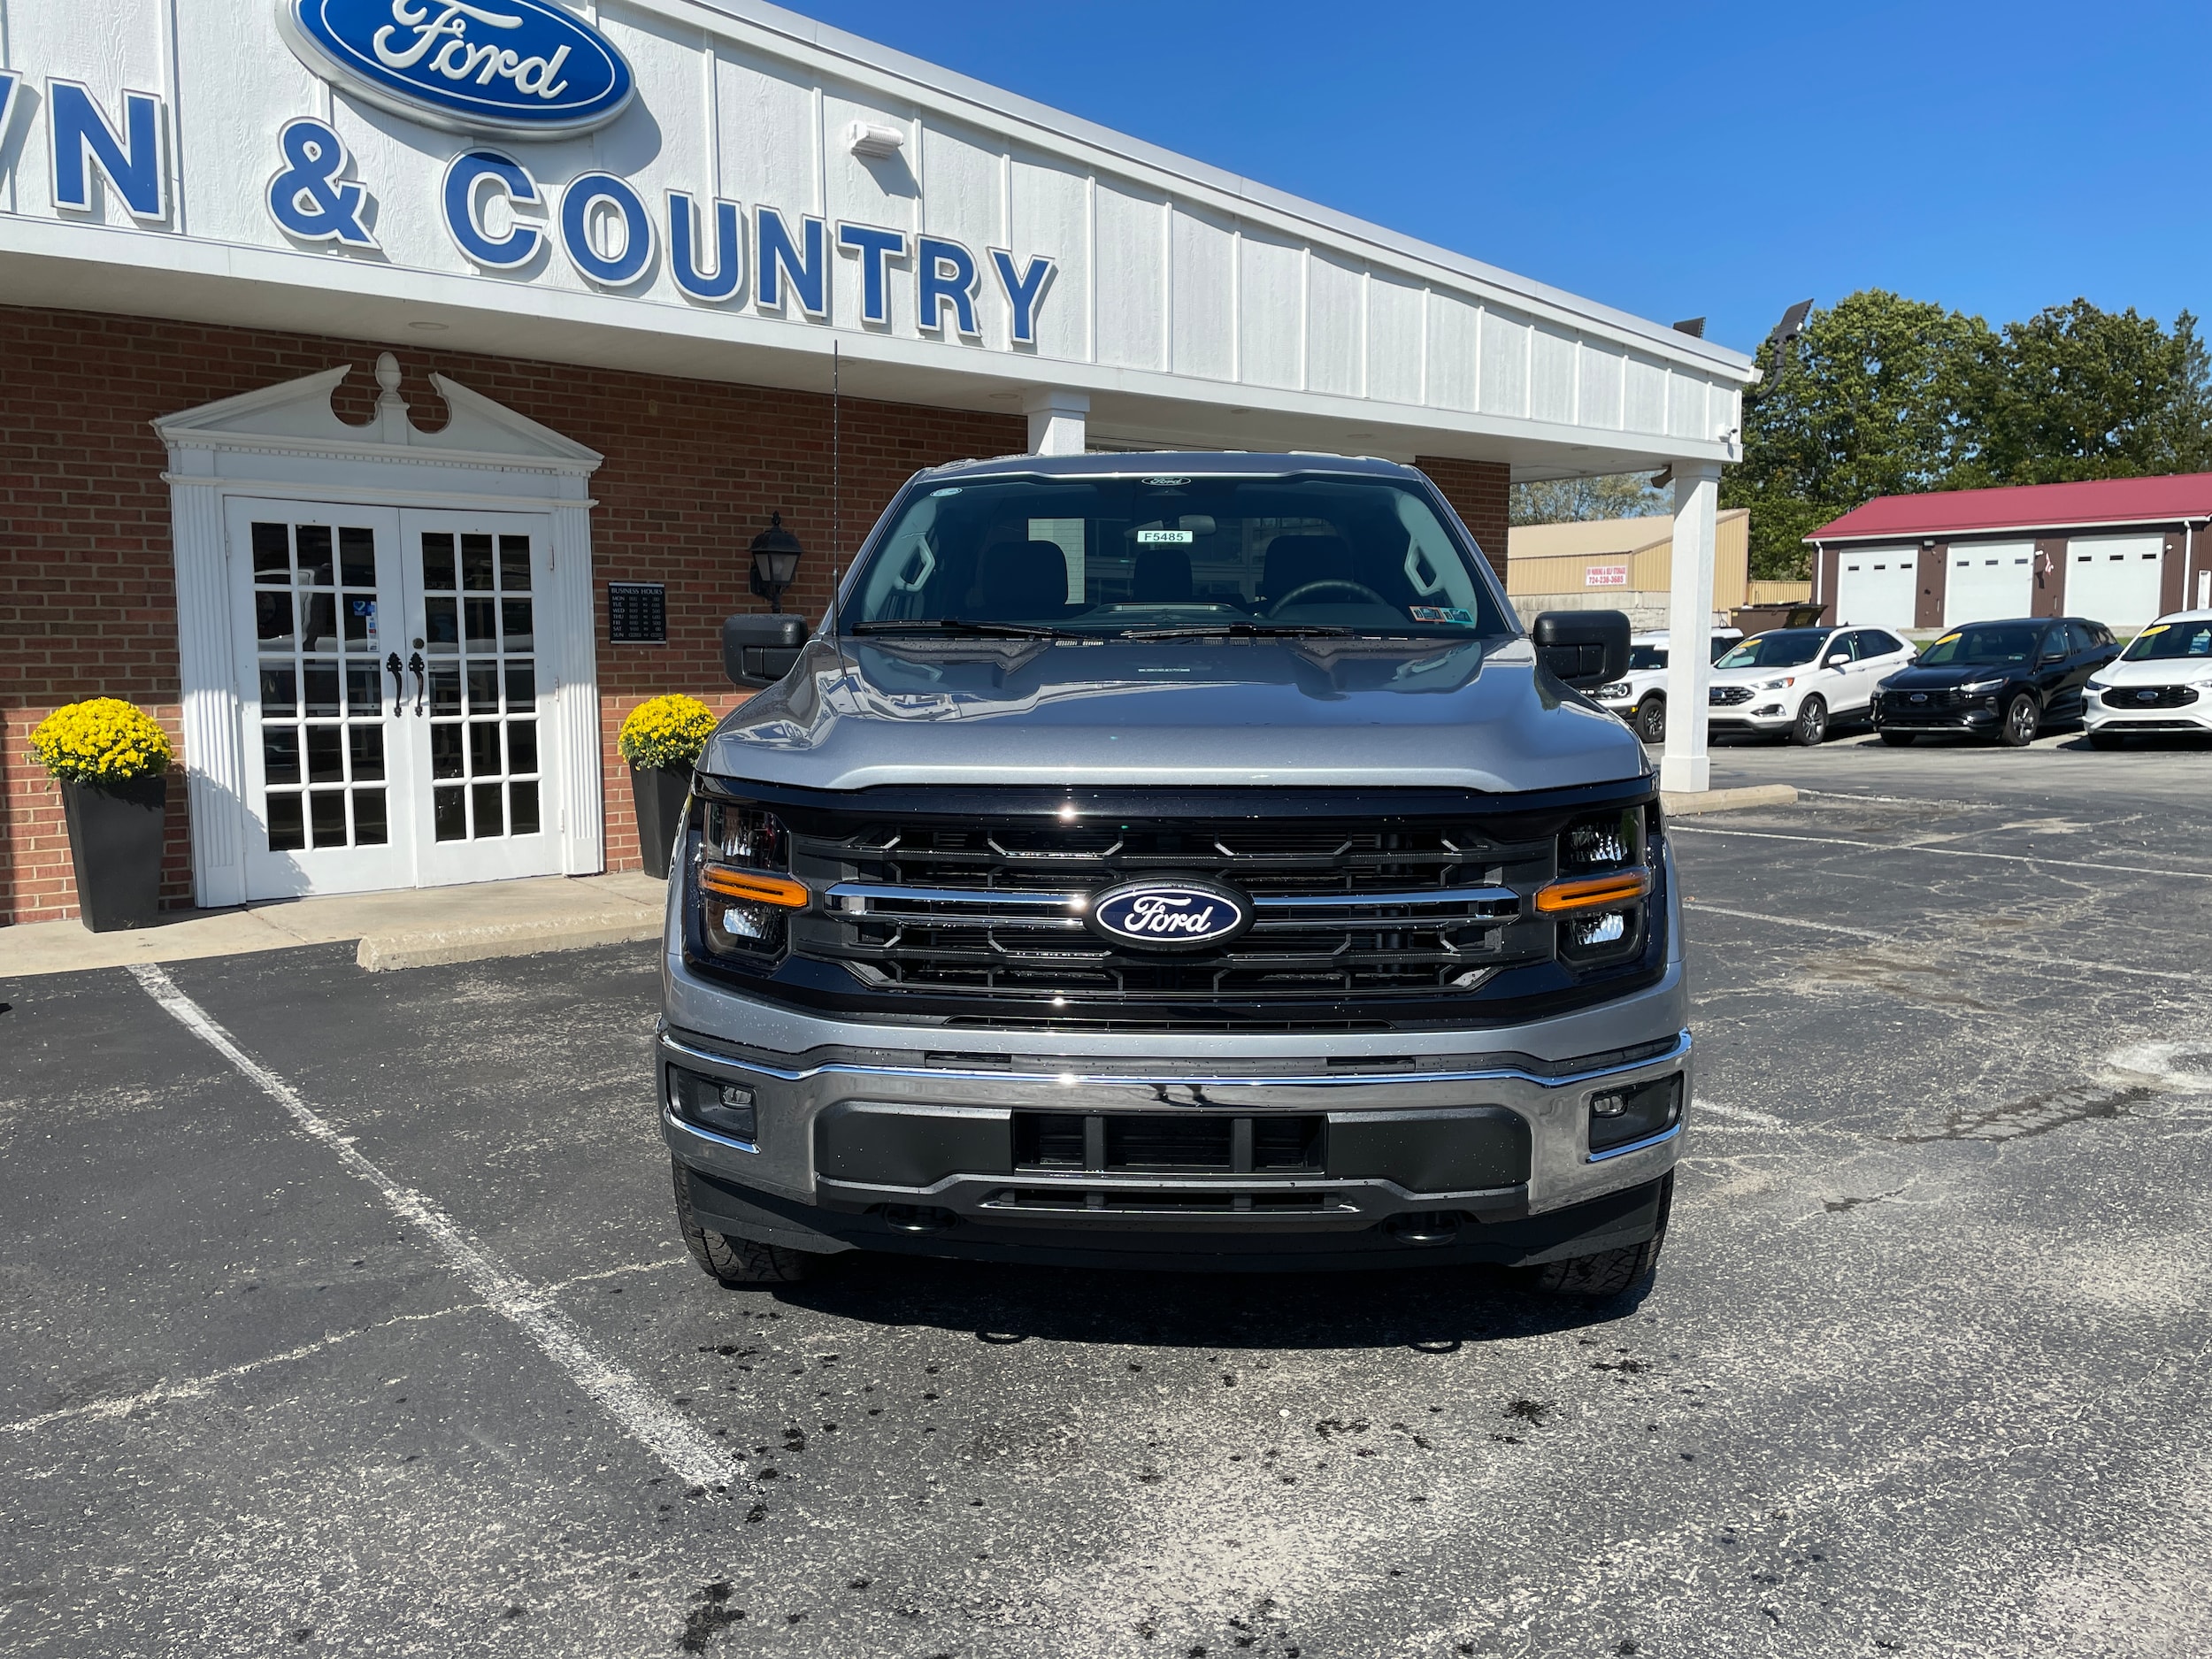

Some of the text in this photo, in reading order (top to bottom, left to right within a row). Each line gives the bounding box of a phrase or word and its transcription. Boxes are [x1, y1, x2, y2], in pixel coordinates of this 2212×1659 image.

[373, 0, 572, 99] Ford
[266, 116, 382, 250] &
[441, 146, 1056, 344] COUNTRY
[1144, 533, 1184, 541] F5485
[1124, 895, 1214, 933] Ford
